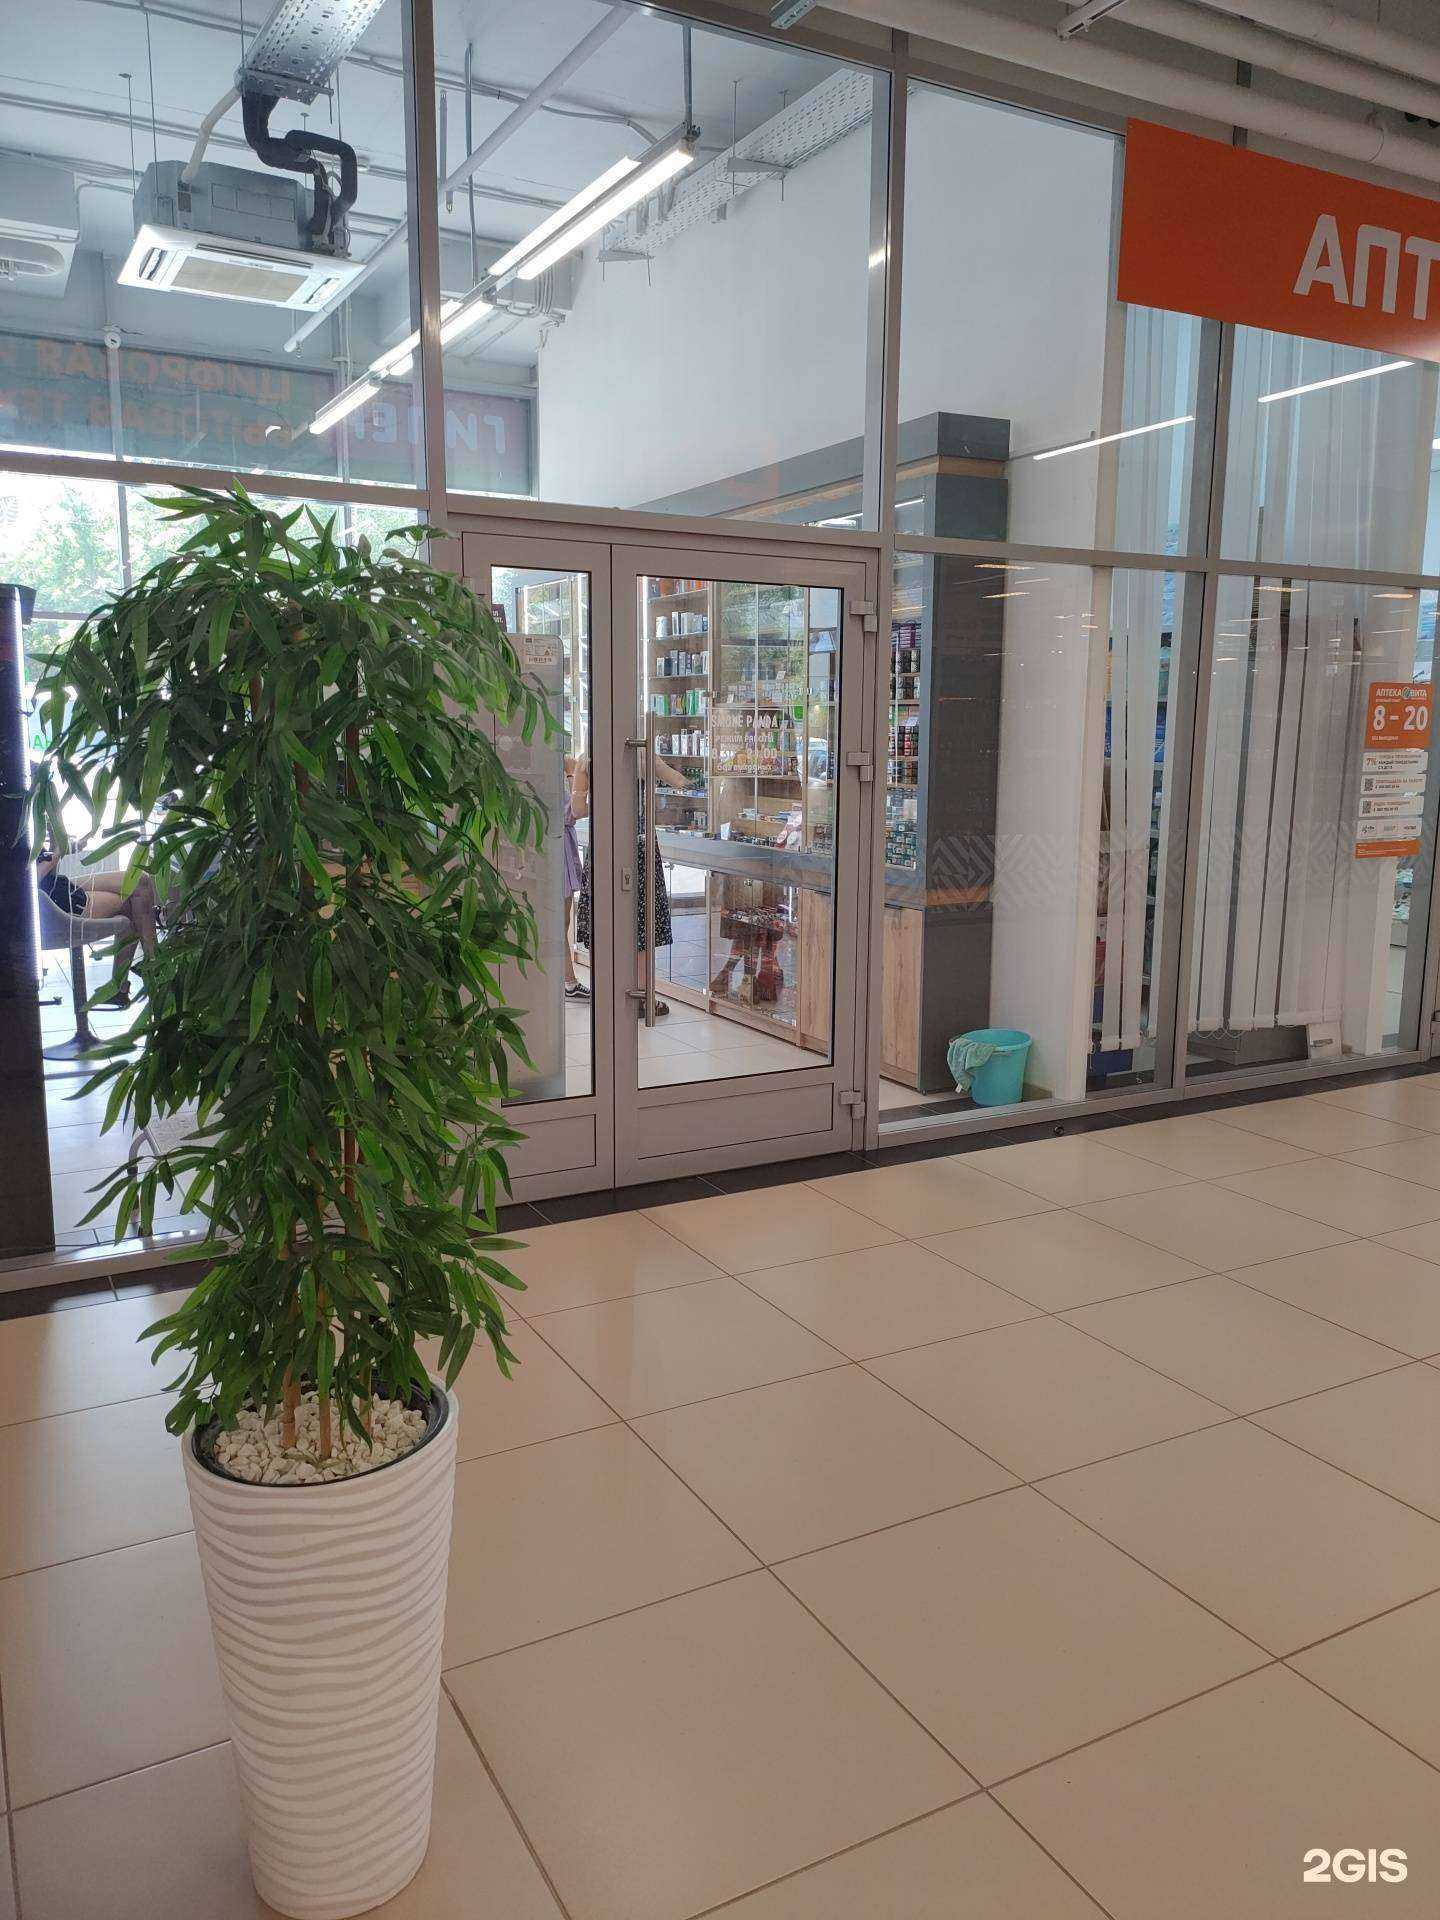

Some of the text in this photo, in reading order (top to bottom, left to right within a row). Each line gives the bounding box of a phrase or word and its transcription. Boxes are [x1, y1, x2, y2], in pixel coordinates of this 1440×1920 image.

[1293, 213, 1440, 321] АПТ
[1373, 705, 1385, 730] 8
[1403, 705, 1428, 731] 20
